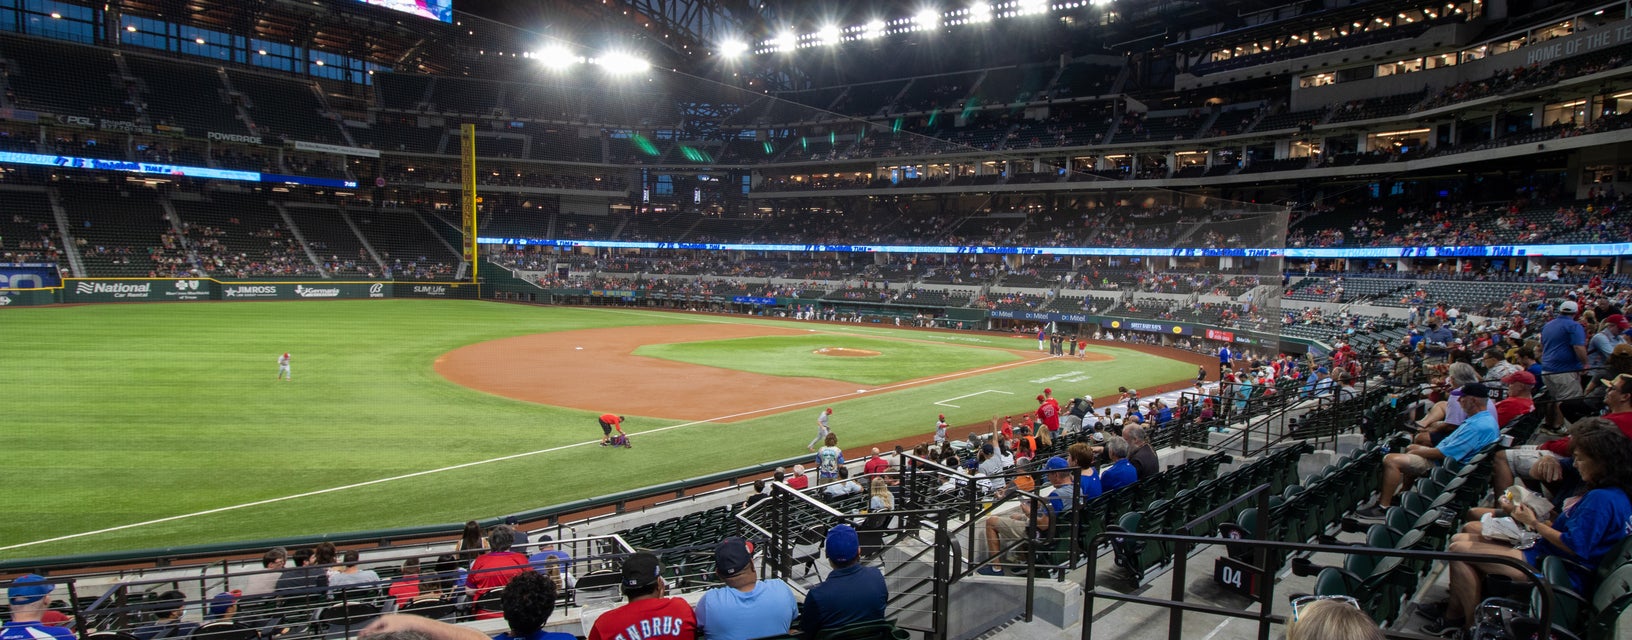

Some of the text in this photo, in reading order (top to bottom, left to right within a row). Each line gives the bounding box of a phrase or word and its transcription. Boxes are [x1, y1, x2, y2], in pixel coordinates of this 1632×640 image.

[1527, 43, 1562, 64] HOME
[1566, 38, 1583, 54] OF
[1587, 30, 1610, 50] THE
[208, 131, 263, 145] POWERADE
[94, 282, 151, 293] National
[1069, 314, 1086, 322] Mitel
[1489, 389, 1499, 398] 05
[1222, 566, 1242, 588] 04
